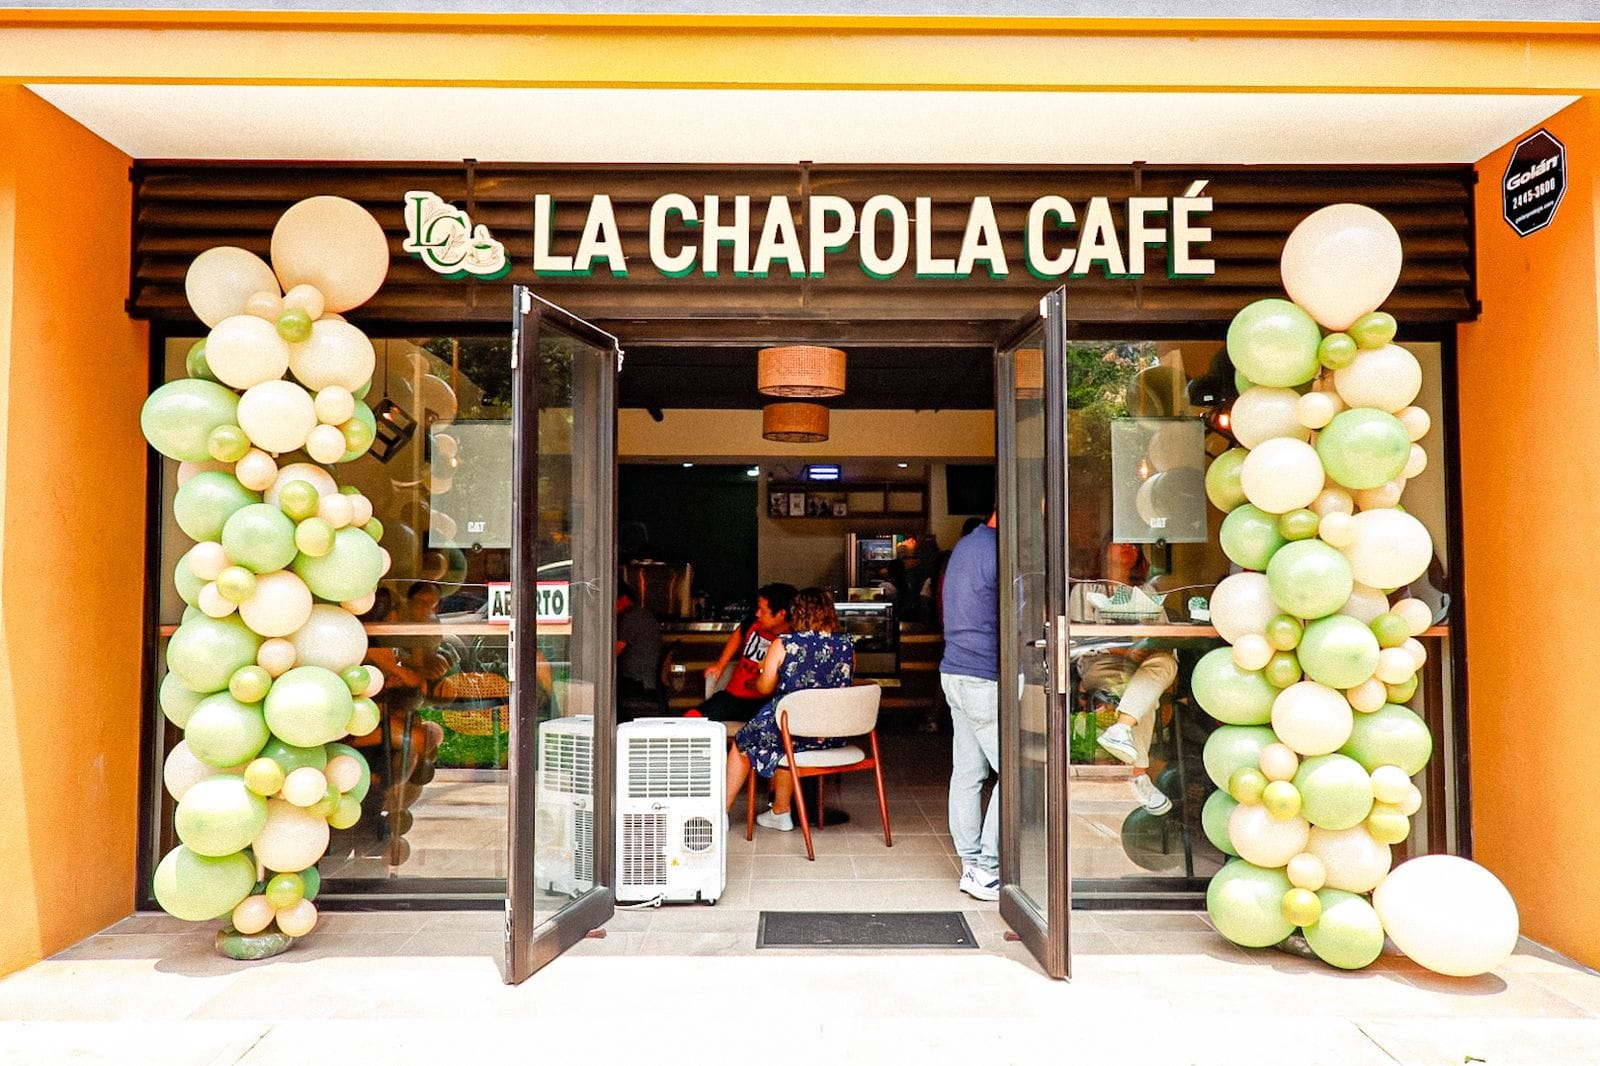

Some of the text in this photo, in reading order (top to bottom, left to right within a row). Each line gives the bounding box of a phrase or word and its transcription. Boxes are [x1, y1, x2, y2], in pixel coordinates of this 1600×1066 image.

[533, 179, 1216, 280] LA CHAPOLA CAFÉ
[492, 589, 564, 616] ABRTO
